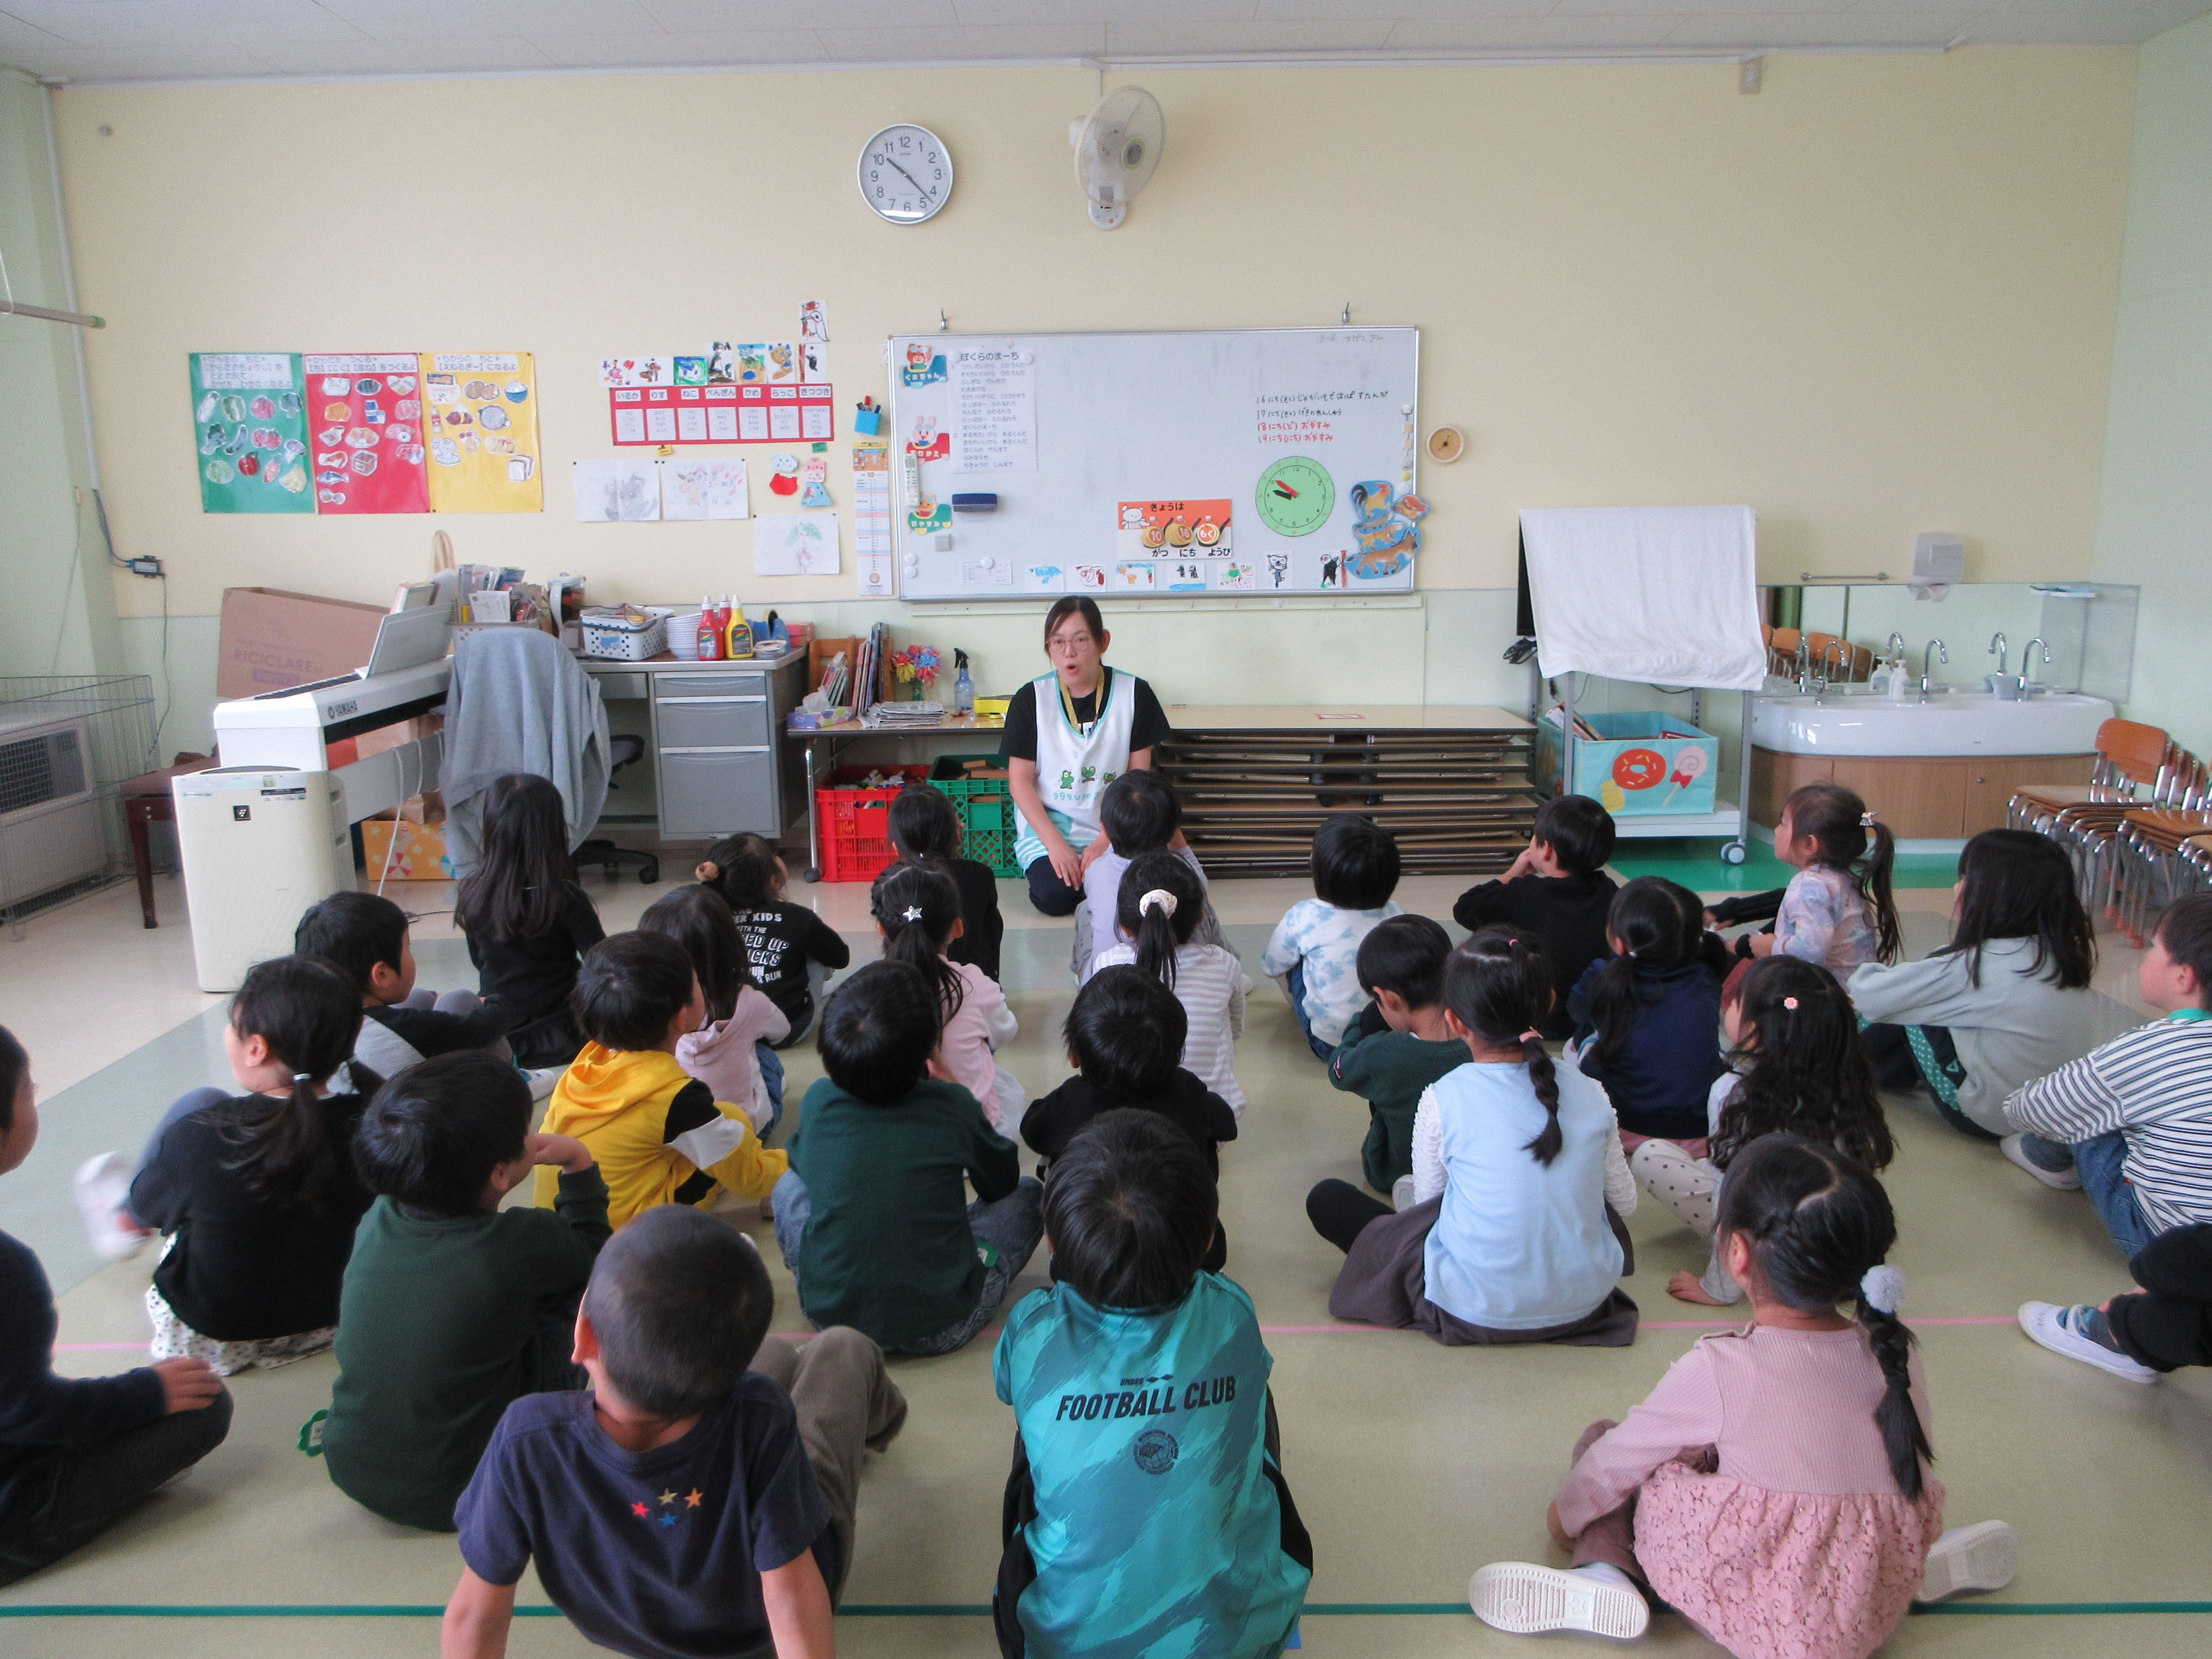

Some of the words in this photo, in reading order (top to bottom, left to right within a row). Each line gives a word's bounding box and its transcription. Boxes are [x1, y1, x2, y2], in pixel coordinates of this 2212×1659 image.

[885, 142, 893, 153] 11
[899, 137, 910, 148] 12
[918, 141, 923, 151] 1
[874, 154, 884, 165] 10
[928, 152, 936, 163] 2
[871, 171, 878, 182] 9
[934, 169, 942, 180] 3
[877, 187, 884, 198] 8
[930, 186, 937, 195] 4
[889, 199, 896, 210] 7
[903, 202, 911, 212] 6
[920, 197, 926, 209] 5
[961, 352, 1019, 361] ぼくらのまーち
[905, 373, 939, 381] くまちゃん
[1150, 503, 1185, 512] きょうは
[1151, 530, 1162, 541] 10
[1179, 528, 1190, 538] 16
[1199, 529, 1214, 538] もく
[1152, 548, 1169, 557] がつ
[1179, 548, 1196, 557] にち
[1208, 547, 1231, 556] ようび
[233, 648, 312, 672] RICICLARE
[335, 700, 358, 718] YAMAHA
[733, 914, 747, 924] ER
[752, 912, 783, 923] KIDS
[742, 932, 765, 948] ED
[768, 937, 789, 952] UP
[765, 970, 782, 983] RUN
[1120, 1377, 1144, 1386] UMBRO
[1056, 1386, 1176, 1421] FOOTBALL
[1184, 1374, 1237, 1410] CLUB
